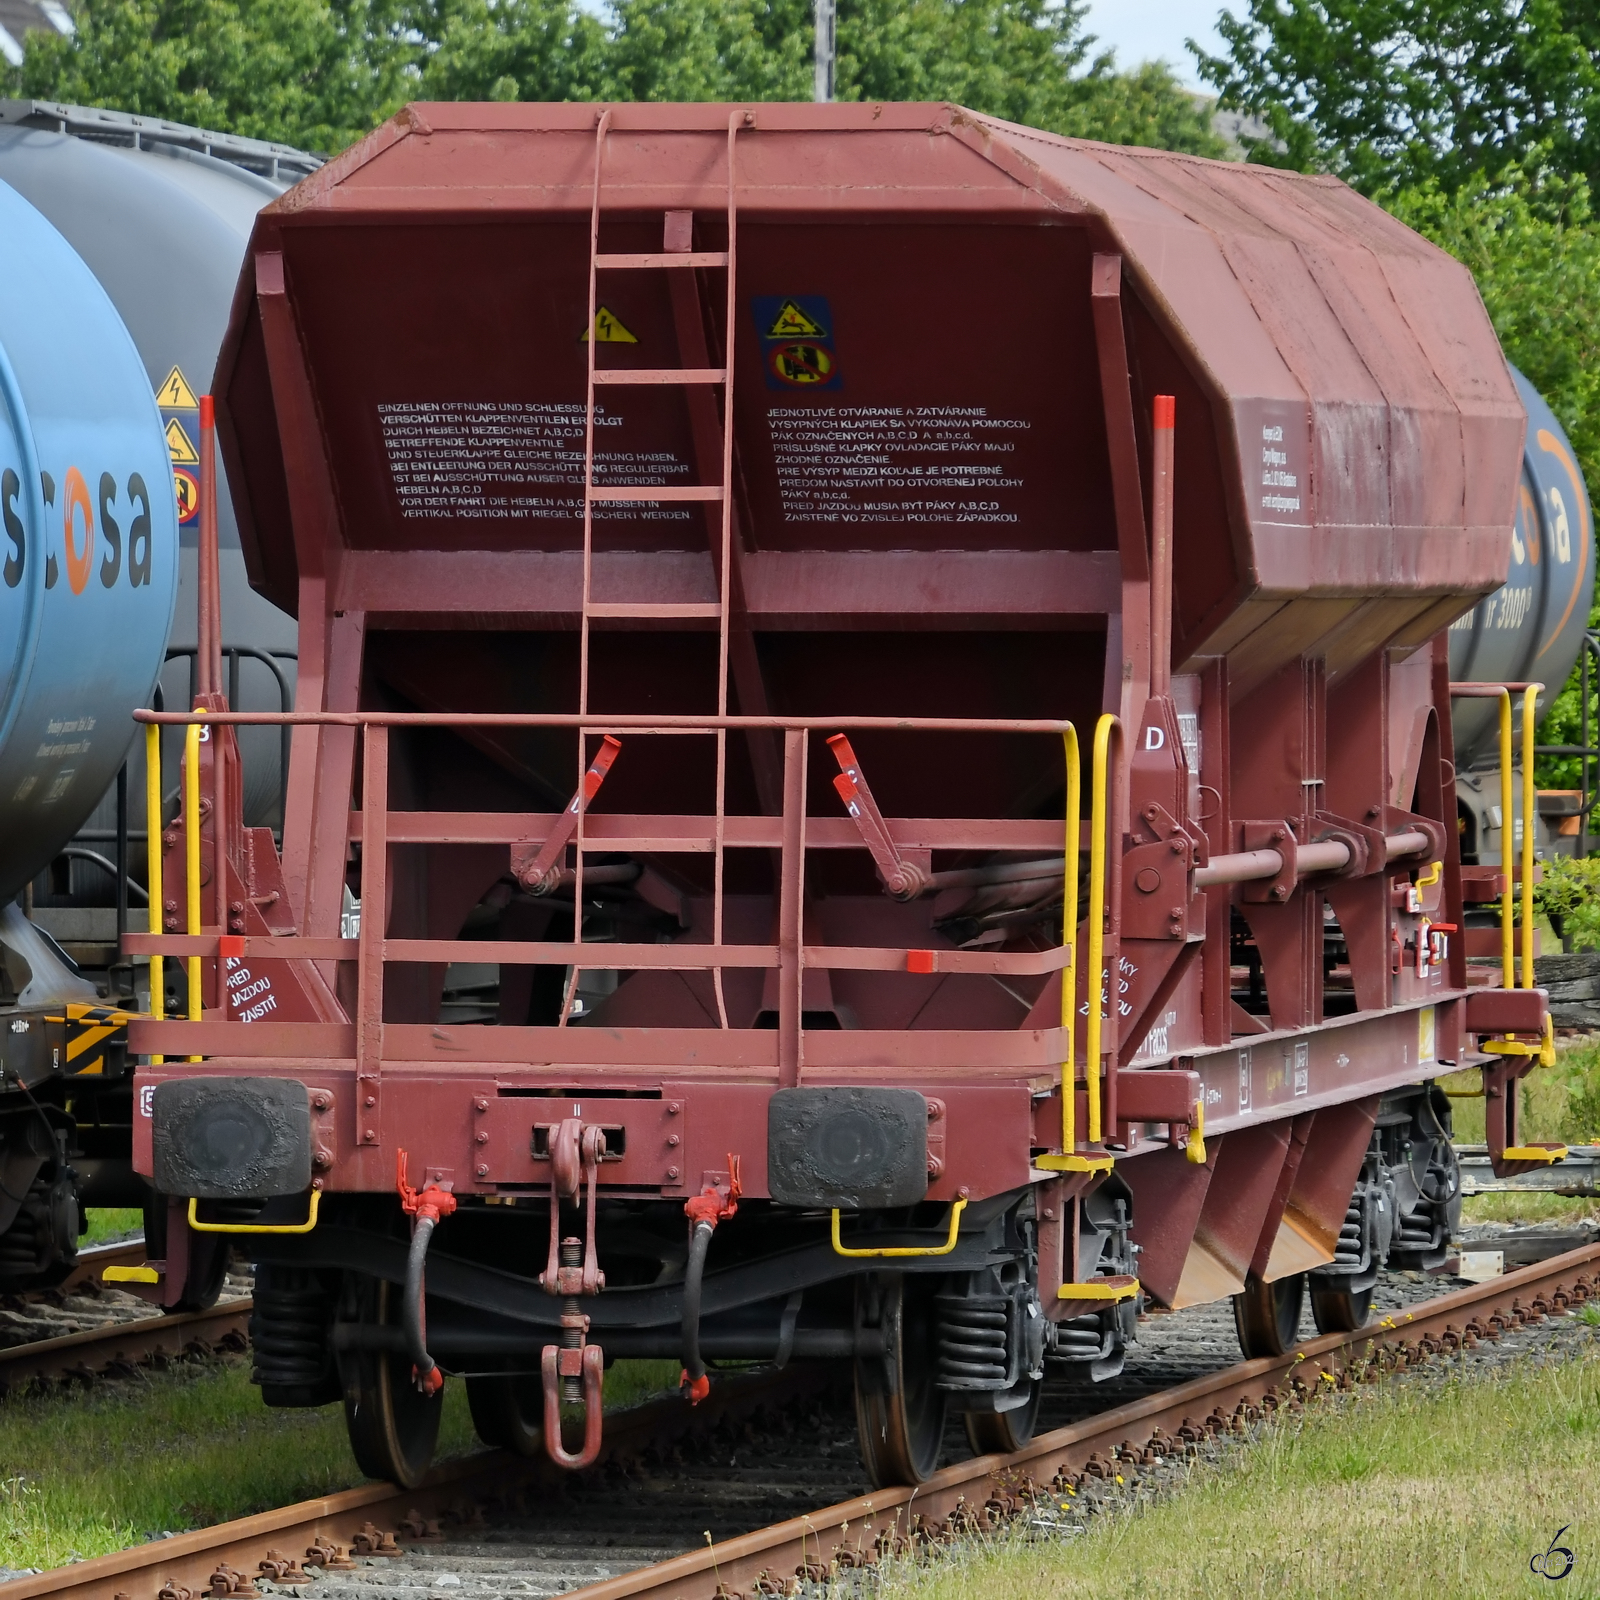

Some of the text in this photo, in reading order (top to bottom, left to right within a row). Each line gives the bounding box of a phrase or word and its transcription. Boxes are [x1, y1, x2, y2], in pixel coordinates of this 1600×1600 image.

[377, 403, 440, 412] EINZELNEN
[499, 403, 523, 412] UND
[525, 404, 605, 414] SCHLIESSUG
[767, 406, 987, 417] JEDNOTLIVÉ OTVÁRANIE A ZATVÁRANIE
[380, 413, 624, 426] VERSCHÜTTEN KLAPPENVENTILEN EROLGT
[840, 419, 889, 428] KLAPIEK
[907, 418, 971, 428] VYKONÁVA
[972, 420, 1031, 428] POMOCOU
[383, 427, 423, 436] DURCH
[425, 426, 470, 436] HEBELN
[471, 426, 541, 436] BEZEICHNET
[923, 432, 932, 440] A
[384, 438, 565, 448] BETREFFENDE KLAPPENVENTILE
[838, 443, 883, 452] KLAPKY
[952, 441, 982, 452] PÁKY
[388, 450, 412, 460] UND
[414, 450, 501, 459] STEUERKLAPPE
[504, 450, 552, 460] GLEICHE
[554, 451, 634, 462] BEZEIHNUNG
[390, 462, 409, 472] BEI
[410, 462, 486, 471] ENTLEERUNG
[488, 462, 512, 470] DER
[610, 464, 690, 473] REGULIERBAR
[777, 467, 801, 476] PRE
[802, 466, 840, 476] VÝSYP
[842, 467, 878, 476] MEDZI
[926, 466, 940, 475] JE
[941, 465, 1004, 475] POTREBNÉ
[393, 474, 410, 482] IST
[412, 474, 431, 482] BEI
[433, 472, 525, 482] AUSSCHÜTTUNG
[526, 474, 565, 484] AUSER
[602, 476, 666, 485] ANWENDEN
[779, 478, 829, 488] PREDOM
[888, 478, 905, 488] DO
[906, 478, 976, 487] OTVORENEJ
[978, 478, 1025, 487] POLOHY
[396, 485, 440, 495] HEBELN
[780, 488, 811, 498] PÁKY
[398, 497, 423, 506] VOR
[424, 497, 448, 506] DER
[450, 496, 488, 506] FAHRT
[489, 497, 508, 506] DIE
[510, 498, 555, 507] HEBELN
[648, 500, 660, 508] IN
[783, 502, 814, 510] PRED
[816, 502, 862, 512] JAZDOU
[863, 502, 900, 512] MUSIA
[926, 500, 956, 510] PÁKY
[402, 509, 454, 518] VERTIKAL
[456, 508, 509, 518] POSITION
[510, 509, 530, 518] MIT
[532, 509, 574, 519] RIEGEL
[841, 514, 860, 522] VO
[860, 514, 905, 522] ZVISLEJ
[906, 513, 954, 522] POLOHE
[1144, 726, 1165, 750] D
[231, 976, 271, 1007] JAZDOU
[238, 994, 278, 1023] ZAISTIŤ
